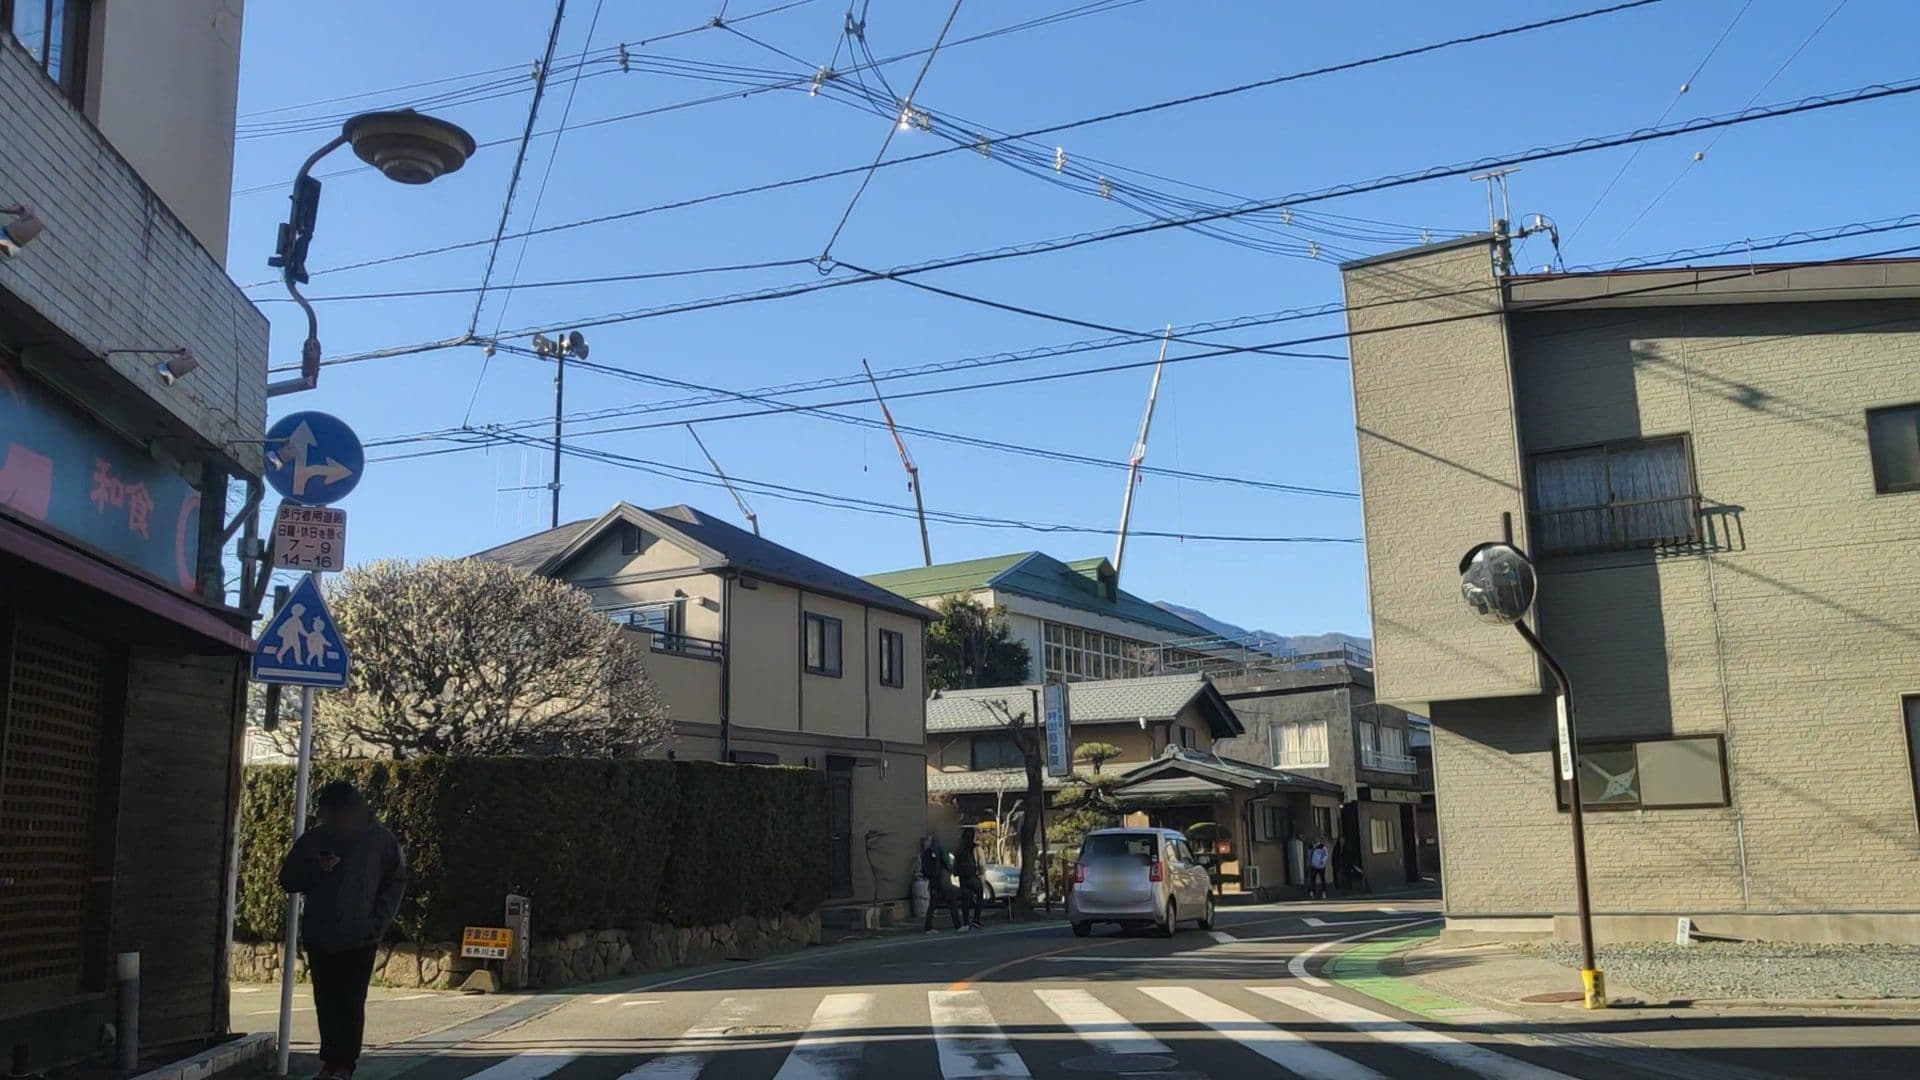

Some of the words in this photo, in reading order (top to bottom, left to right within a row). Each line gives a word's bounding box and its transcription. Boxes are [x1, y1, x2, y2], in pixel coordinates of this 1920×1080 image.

[91, 457, 154, 540] 和食
[280, 508, 343, 524] 歩行者用道路
